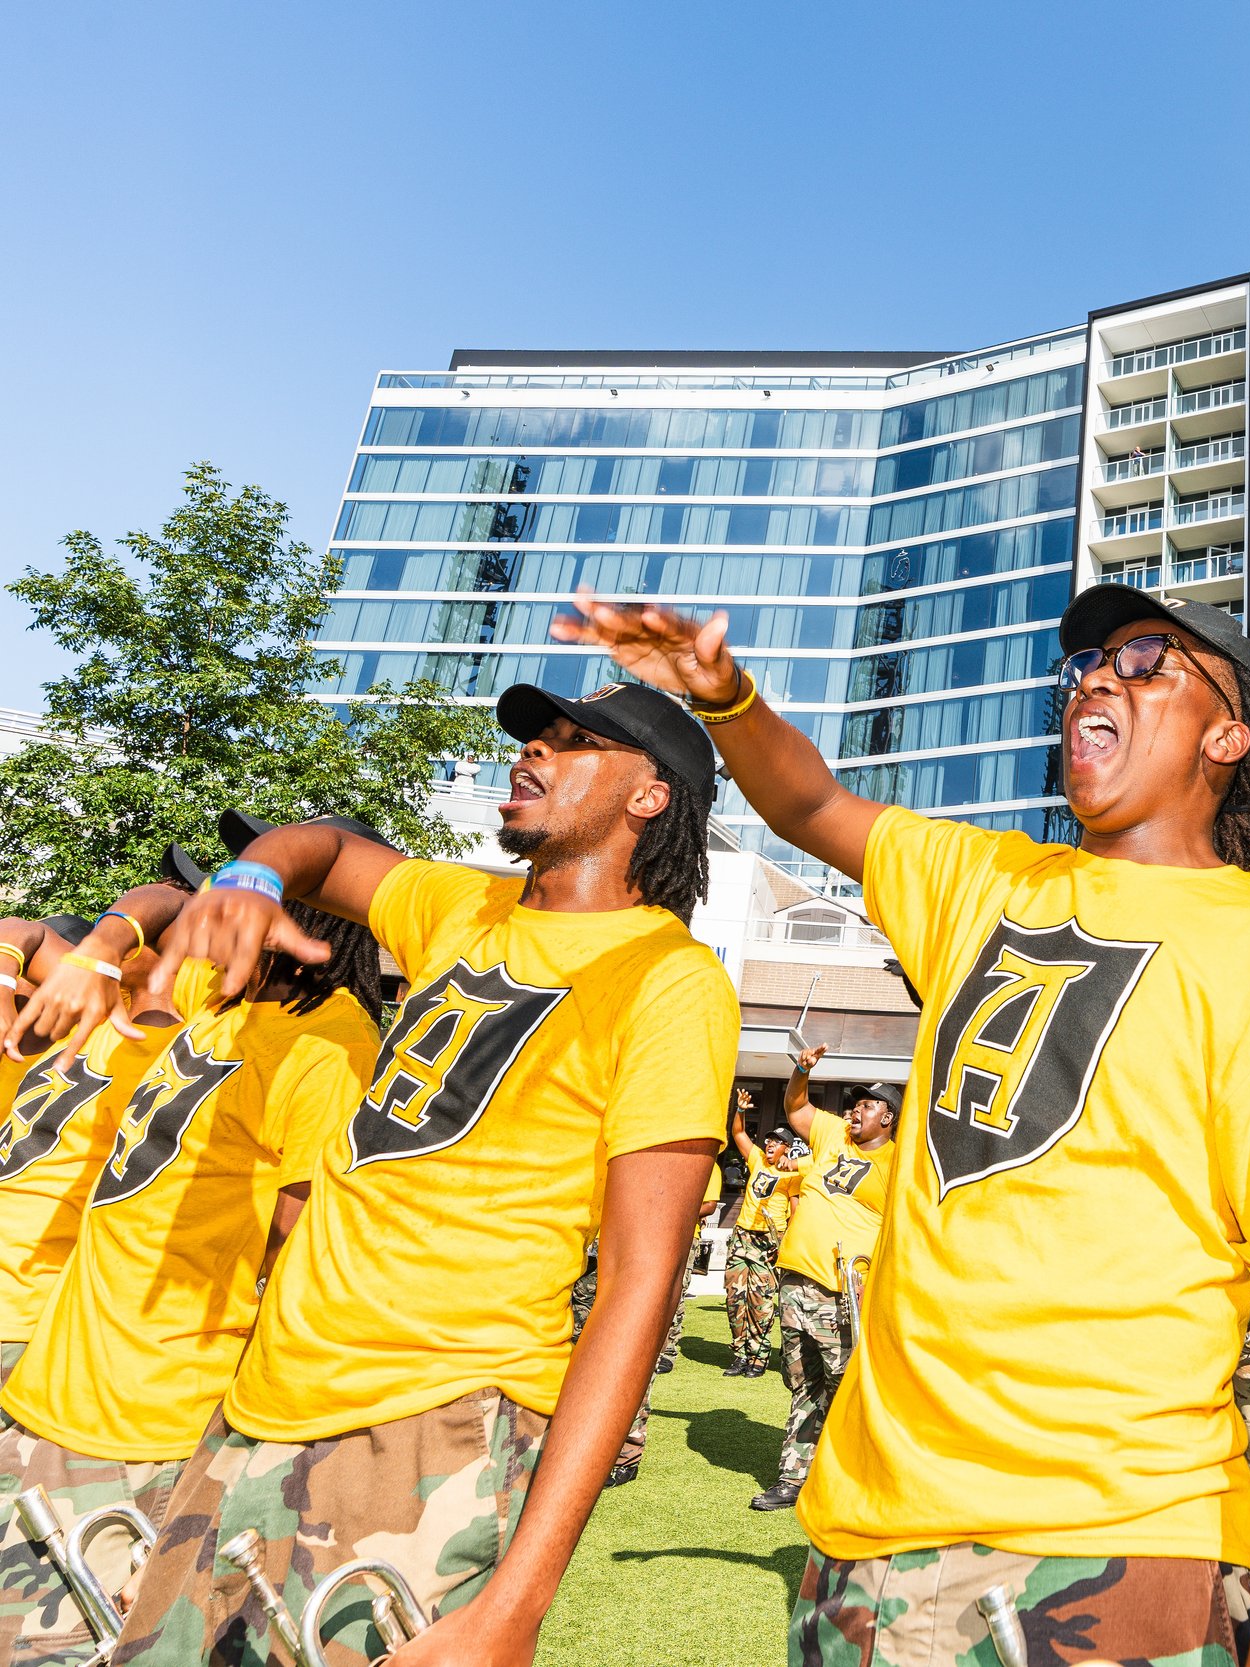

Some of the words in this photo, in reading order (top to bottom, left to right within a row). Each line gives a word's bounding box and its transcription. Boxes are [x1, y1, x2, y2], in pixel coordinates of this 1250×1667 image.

[366, 979, 514, 1132] A
[934, 944, 1096, 1139] A
[827, 1161, 865, 1192] A
